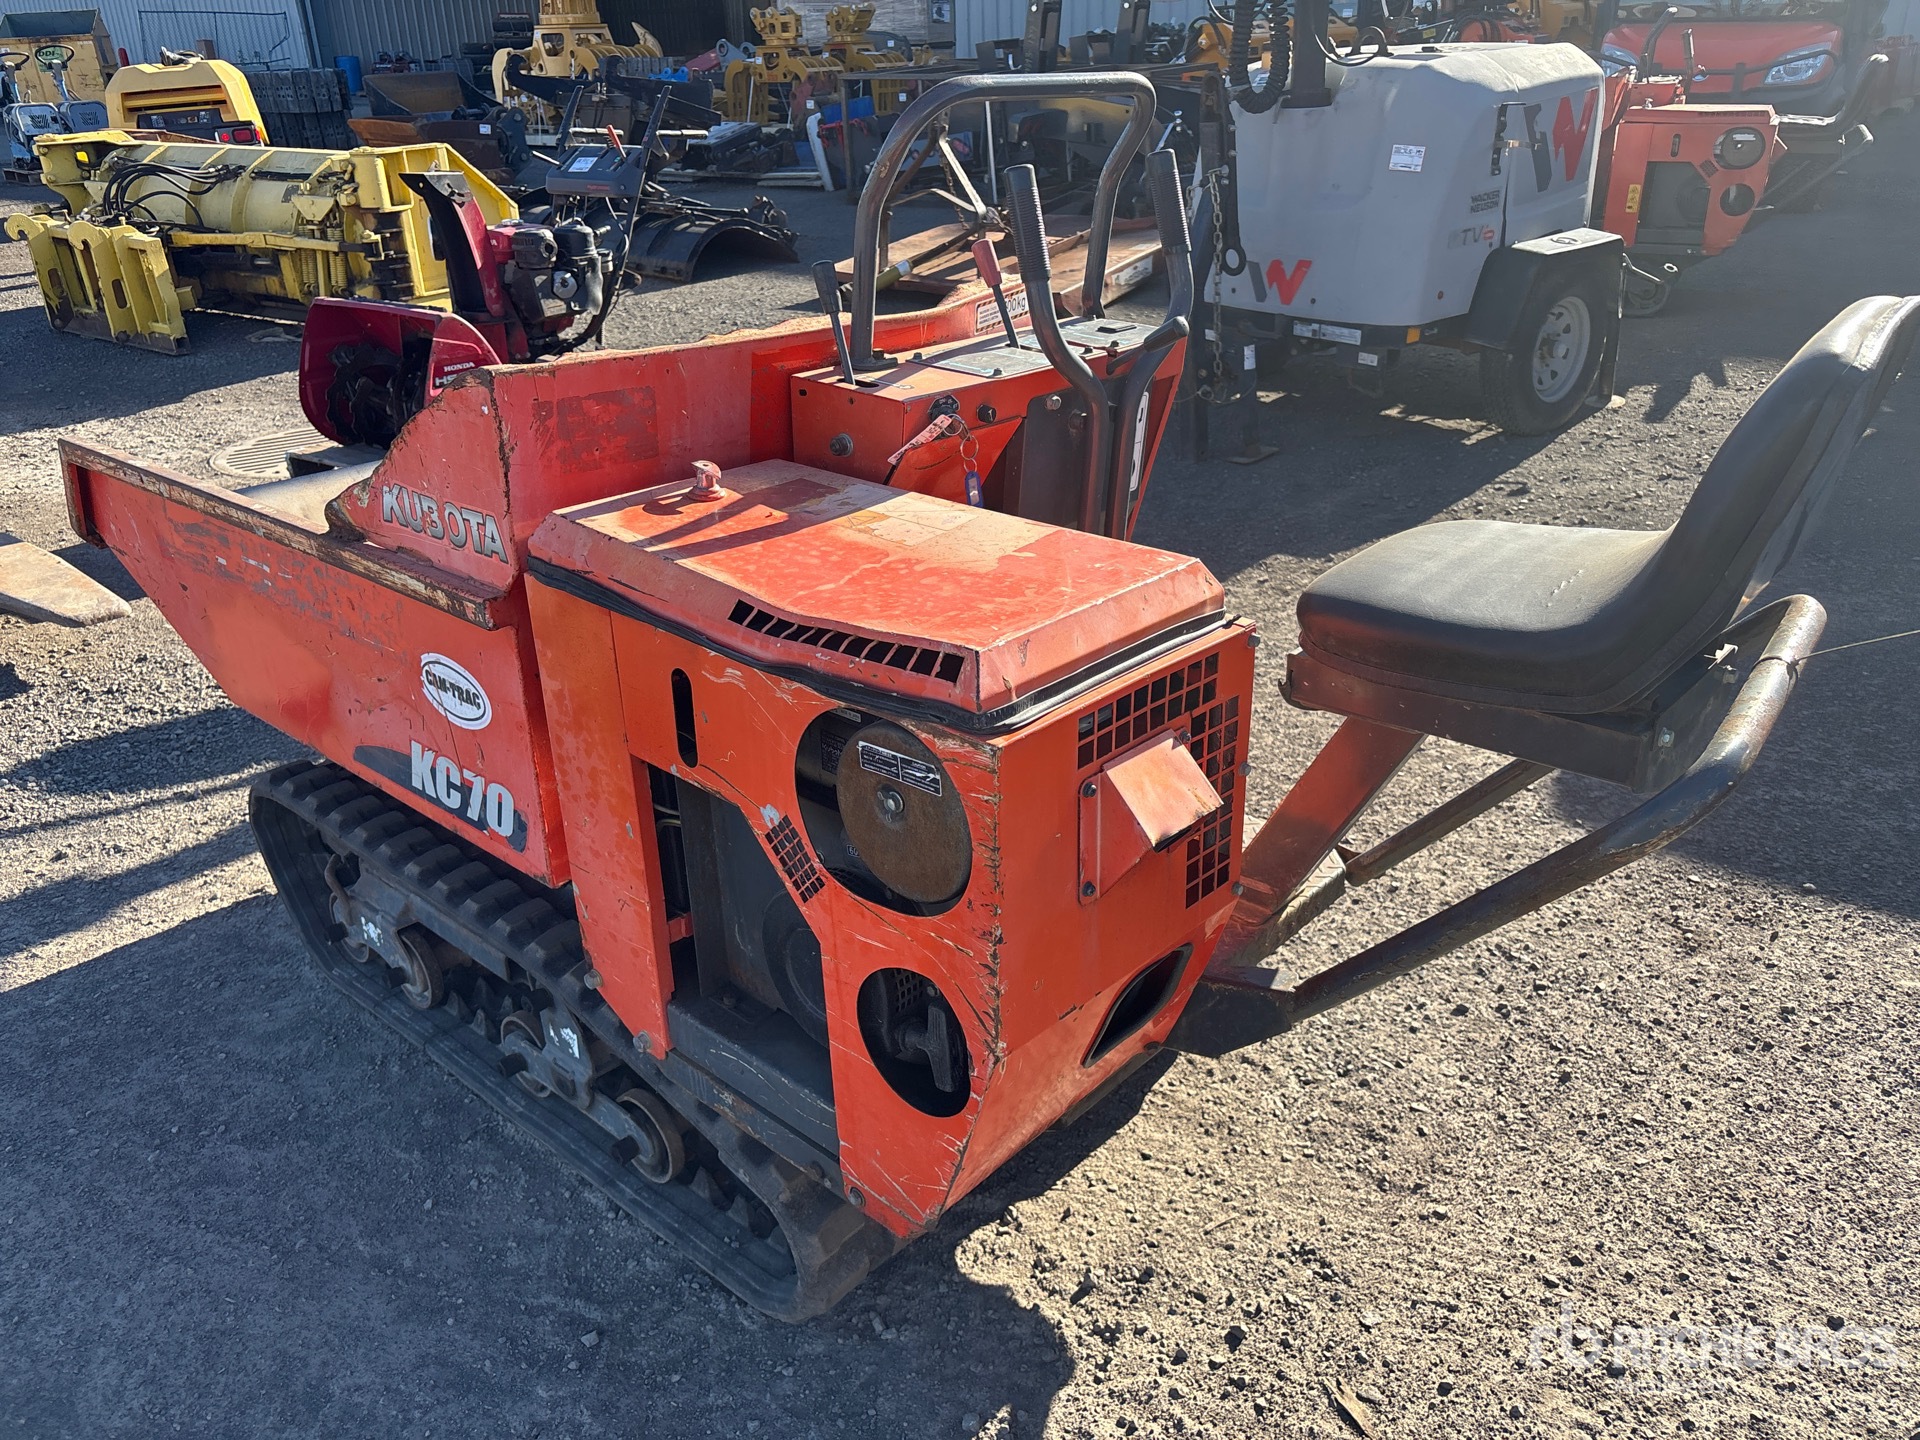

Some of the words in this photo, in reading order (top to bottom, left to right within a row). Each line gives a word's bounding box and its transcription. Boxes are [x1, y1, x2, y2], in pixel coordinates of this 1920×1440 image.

[443, 361, 475, 372] HONDA
[382, 483, 509, 564] KUBOTA
[424, 669, 482, 711] CAM-TRAC
[410, 739, 515, 837] KC70
